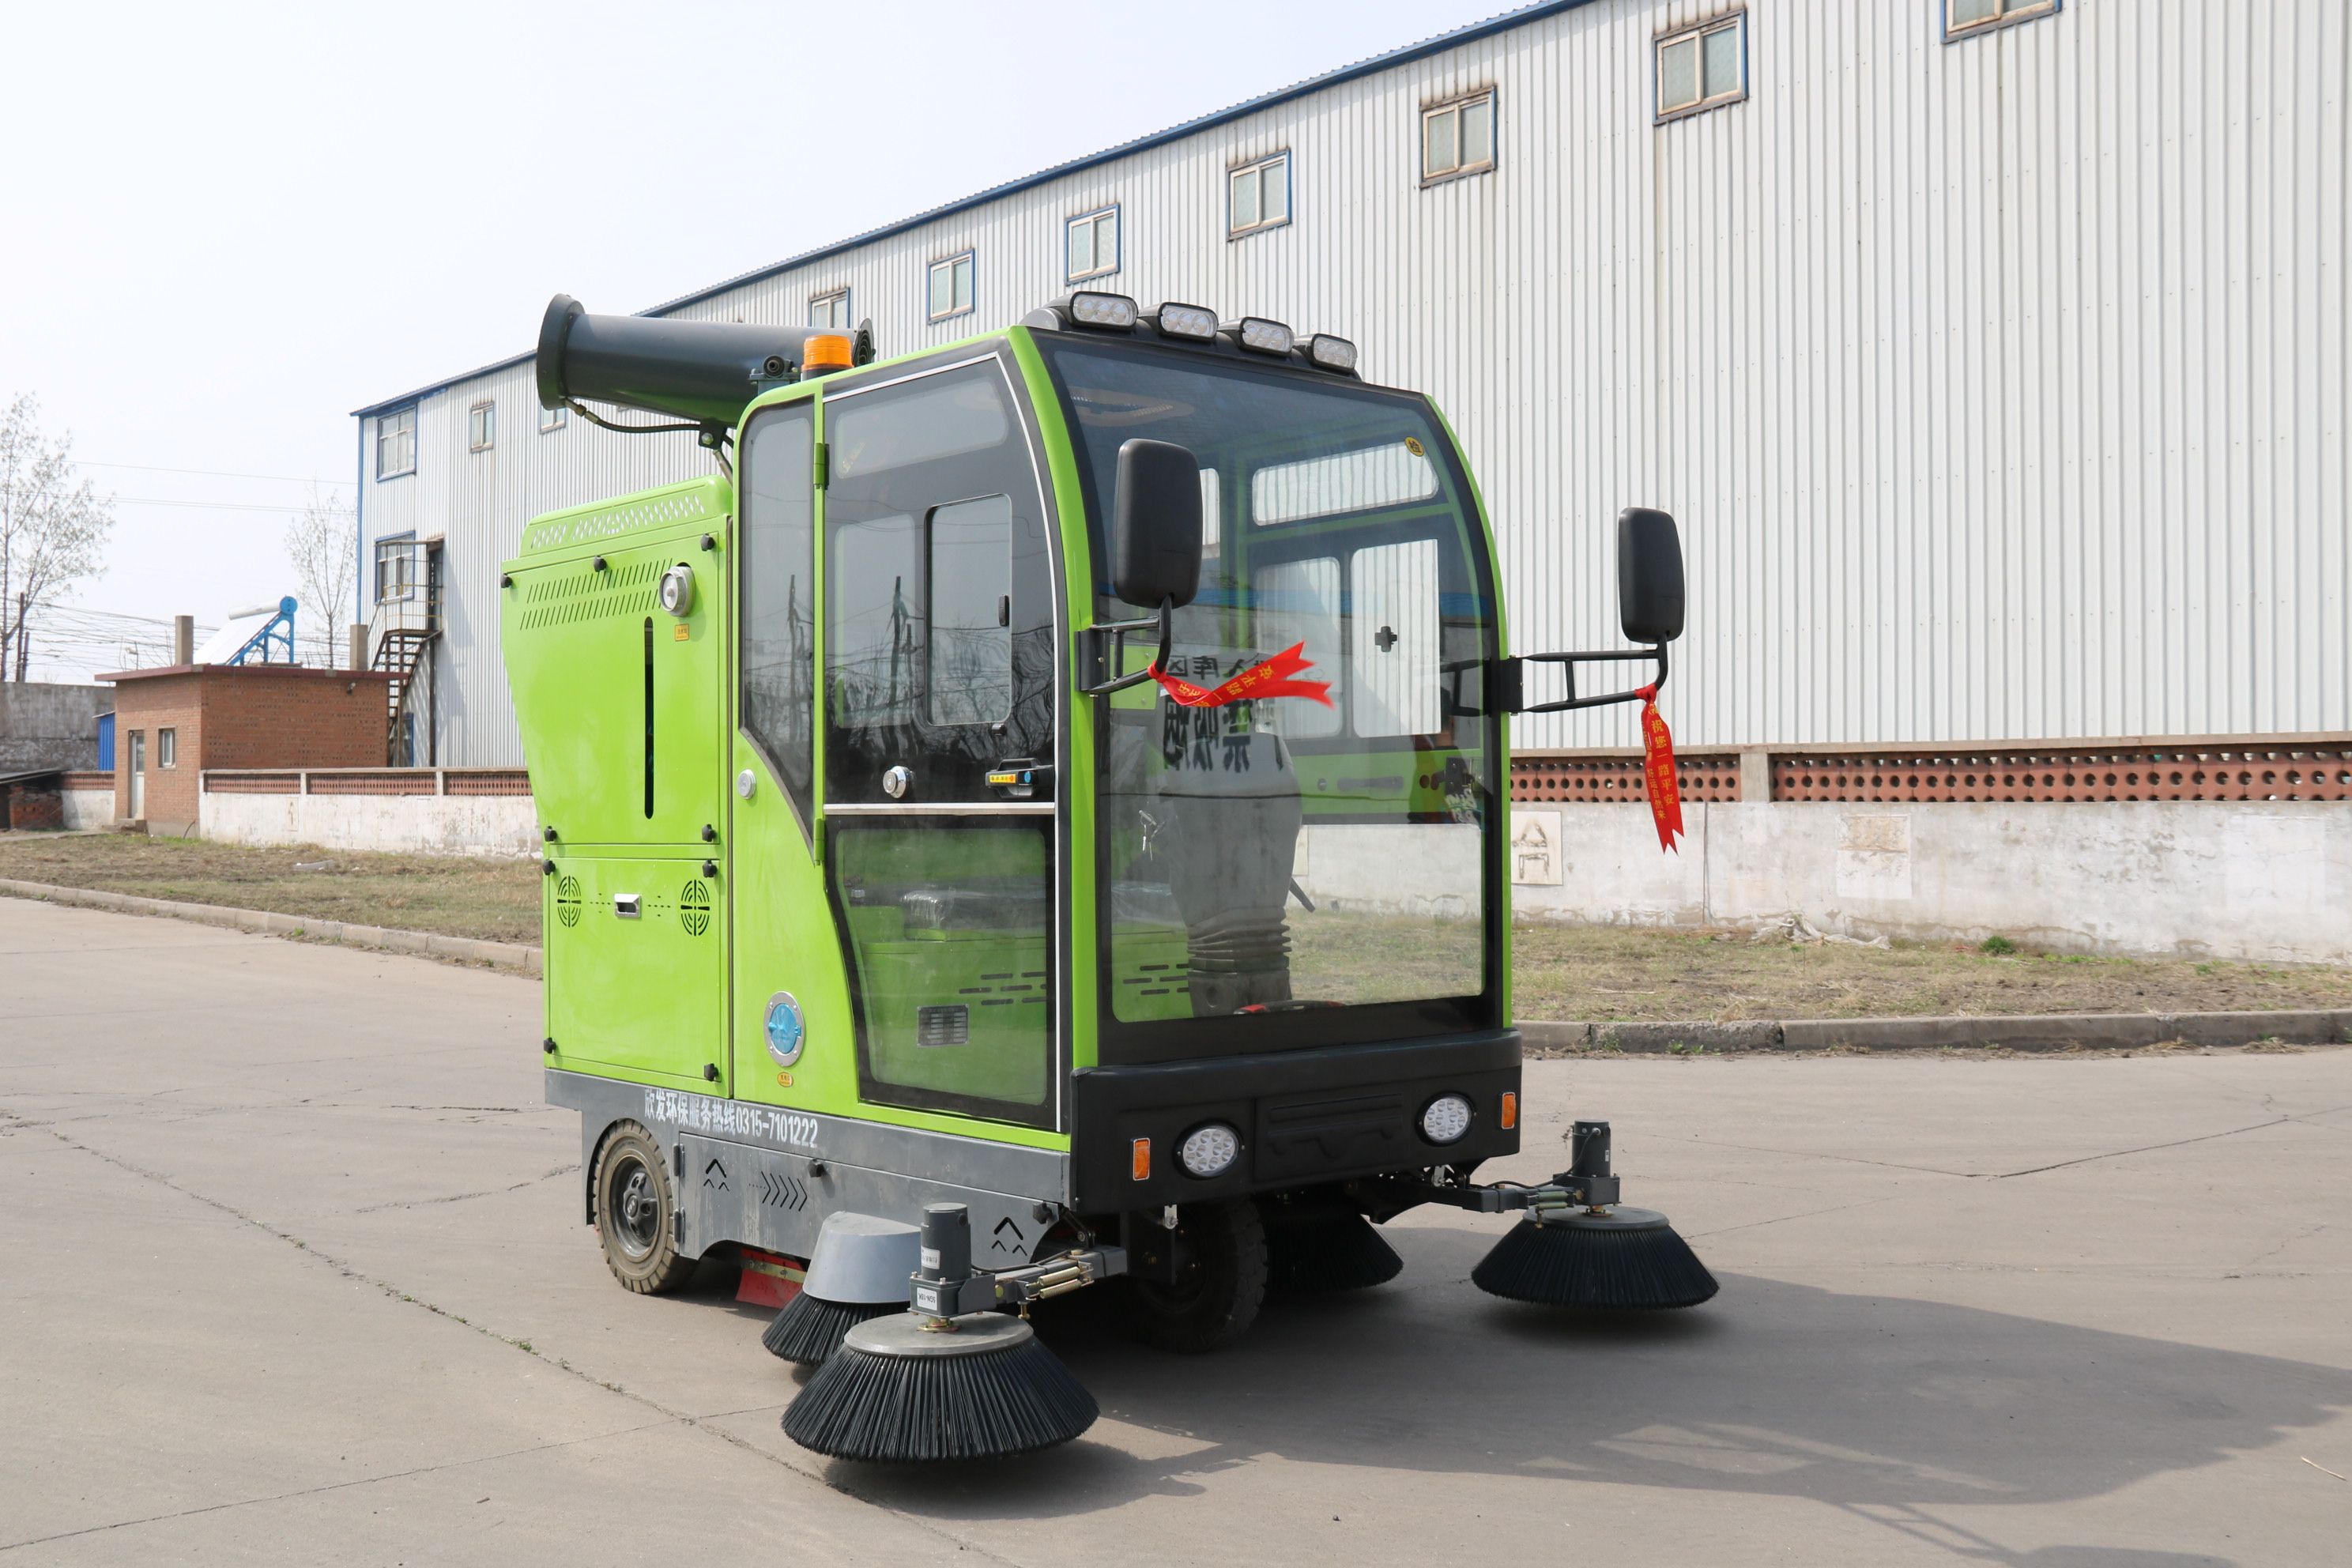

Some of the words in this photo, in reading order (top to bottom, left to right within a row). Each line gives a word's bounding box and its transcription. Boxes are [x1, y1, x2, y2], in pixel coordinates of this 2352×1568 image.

[1650, 719, 1675, 806] 祝您一路平安
